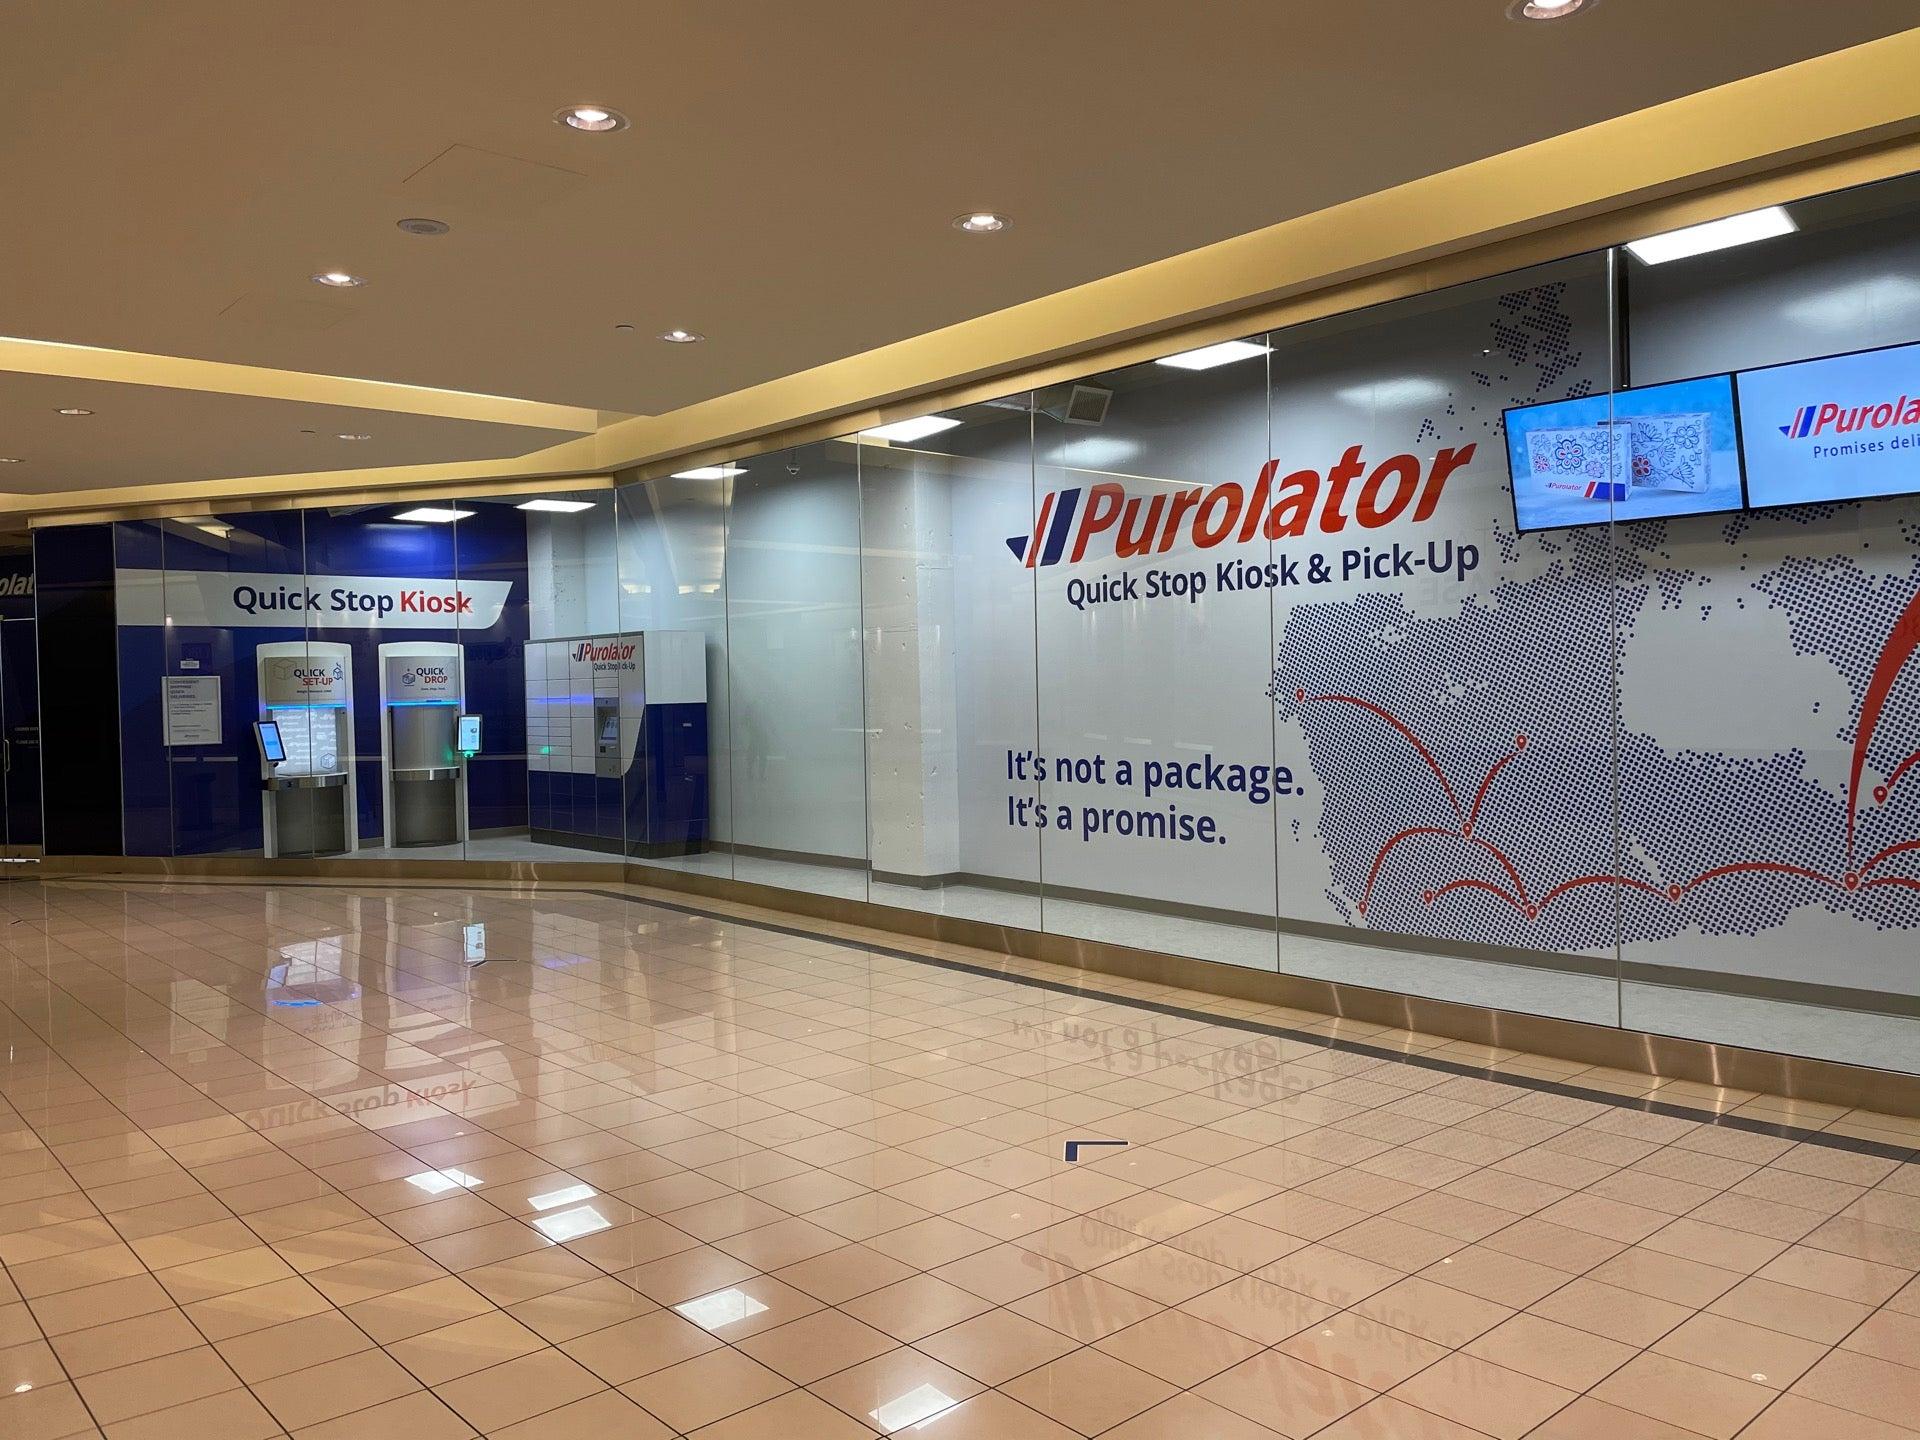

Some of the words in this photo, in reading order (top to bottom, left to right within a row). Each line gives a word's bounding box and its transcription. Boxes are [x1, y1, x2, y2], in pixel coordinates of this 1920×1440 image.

[1813, 395, 1920, 437] Purola
[1813, 441, 1885, 458] Promises
[1550, 481, 1582, 491] Purolator
[1069, 443, 1478, 563] Purolator
[1067, 572, 1138, 610] Quick
[1145, 569, 1206, 604] Stop
[1216, 553, 1299, 592] Kiosk
[1307, 552, 1332, 583] &
[1342, 539, 1480, 581] Pick-Up
[233, 586, 322, 615] Quick
[330, 588, 394, 618] Stop
[400, 590, 473, 613] Kiosk
[294, 668, 325, 678] QUICK
[416, 667, 445, 676] QUICK
[593, 662, 606, 671] Quick
[618, 661, 636, 672] ck-Up
[302, 677, 334, 686] SET-UP
[424, 675, 448, 684] DROP
[1007, 750, 1047, 781] It's
[1056, 754, 1106, 785] not
[1115, 760, 1133, 786] a
[1144, 754, 1305, 804] package.
[1008, 795, 1048, 828] It's
[1056, 804, 1073, 831] a
[1082, 805, 1227, 845] promise.
